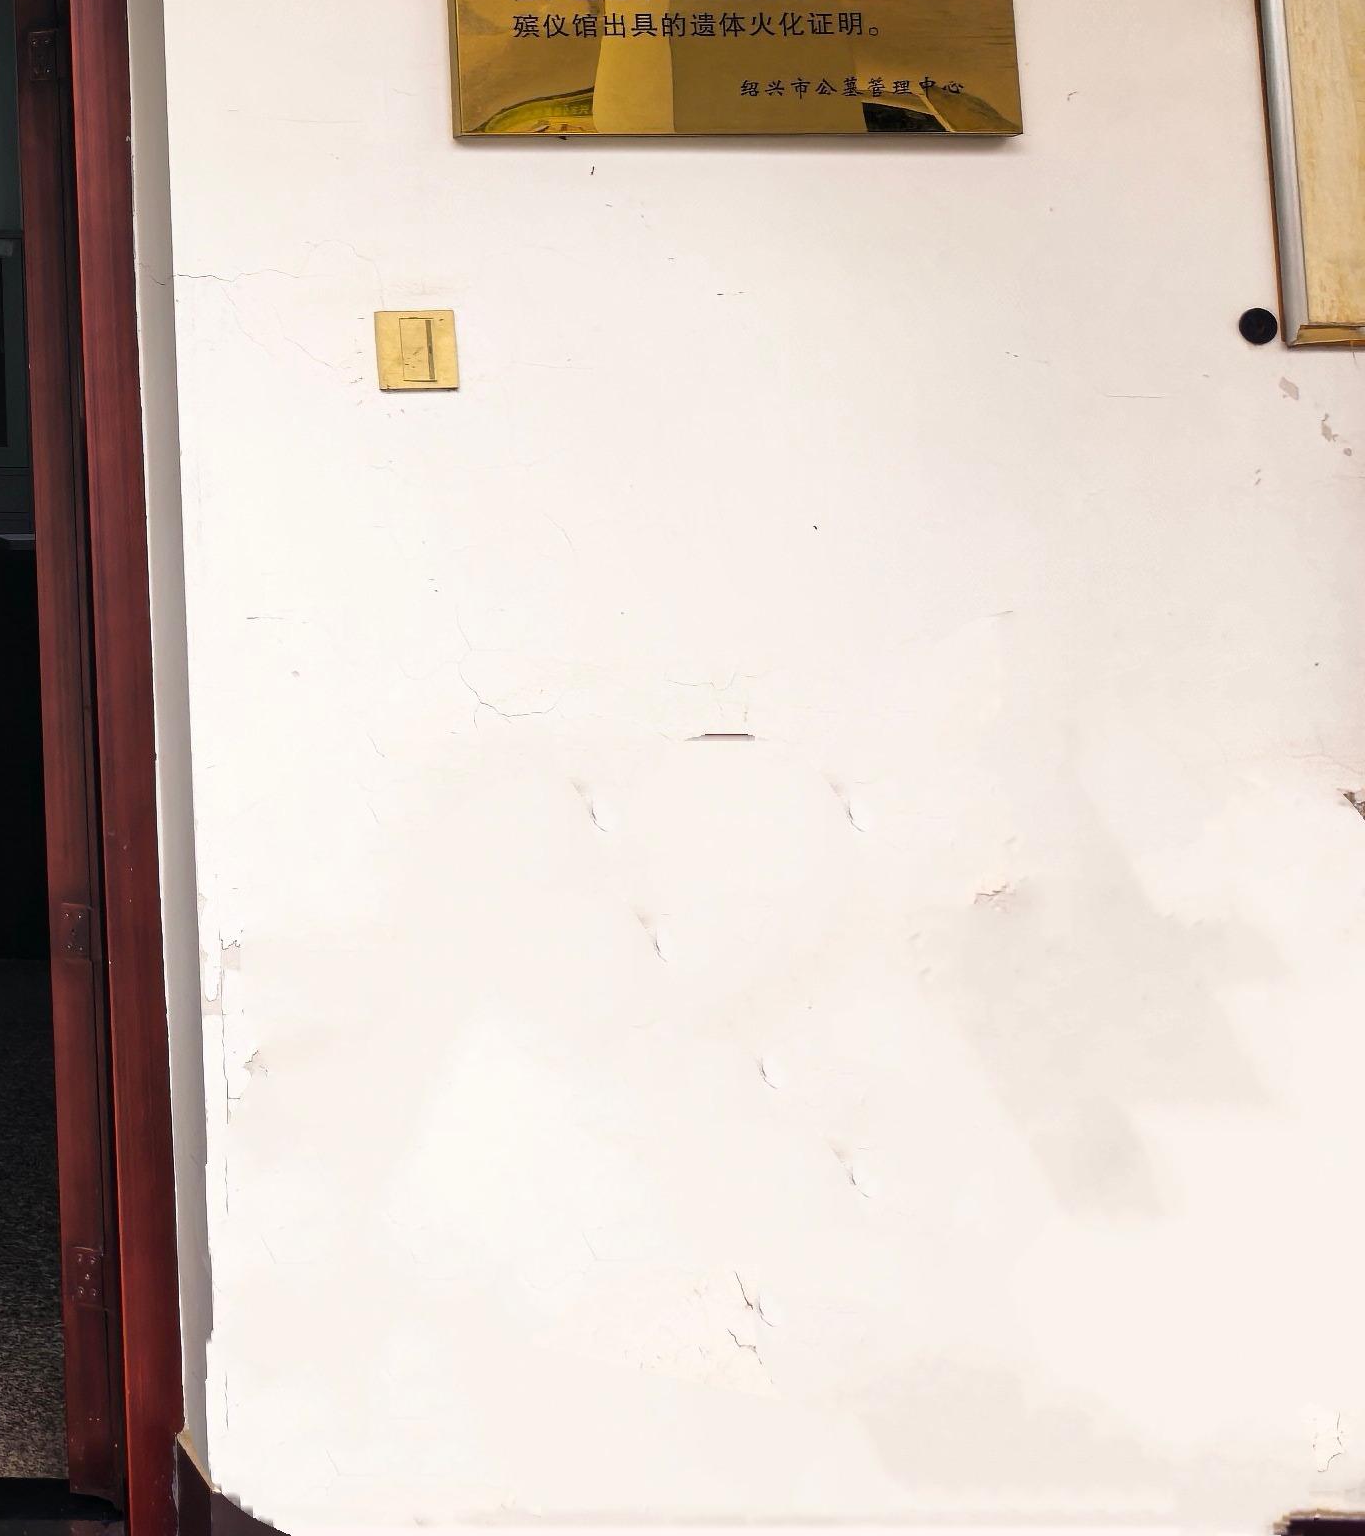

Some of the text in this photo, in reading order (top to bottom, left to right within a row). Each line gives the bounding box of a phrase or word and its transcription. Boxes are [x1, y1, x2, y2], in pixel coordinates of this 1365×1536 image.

[512, 11, 882, 40] 殡仪馆出具的遗体火化证明。
[740, 75, 964, 100] 绍兴市公墓管理中心
